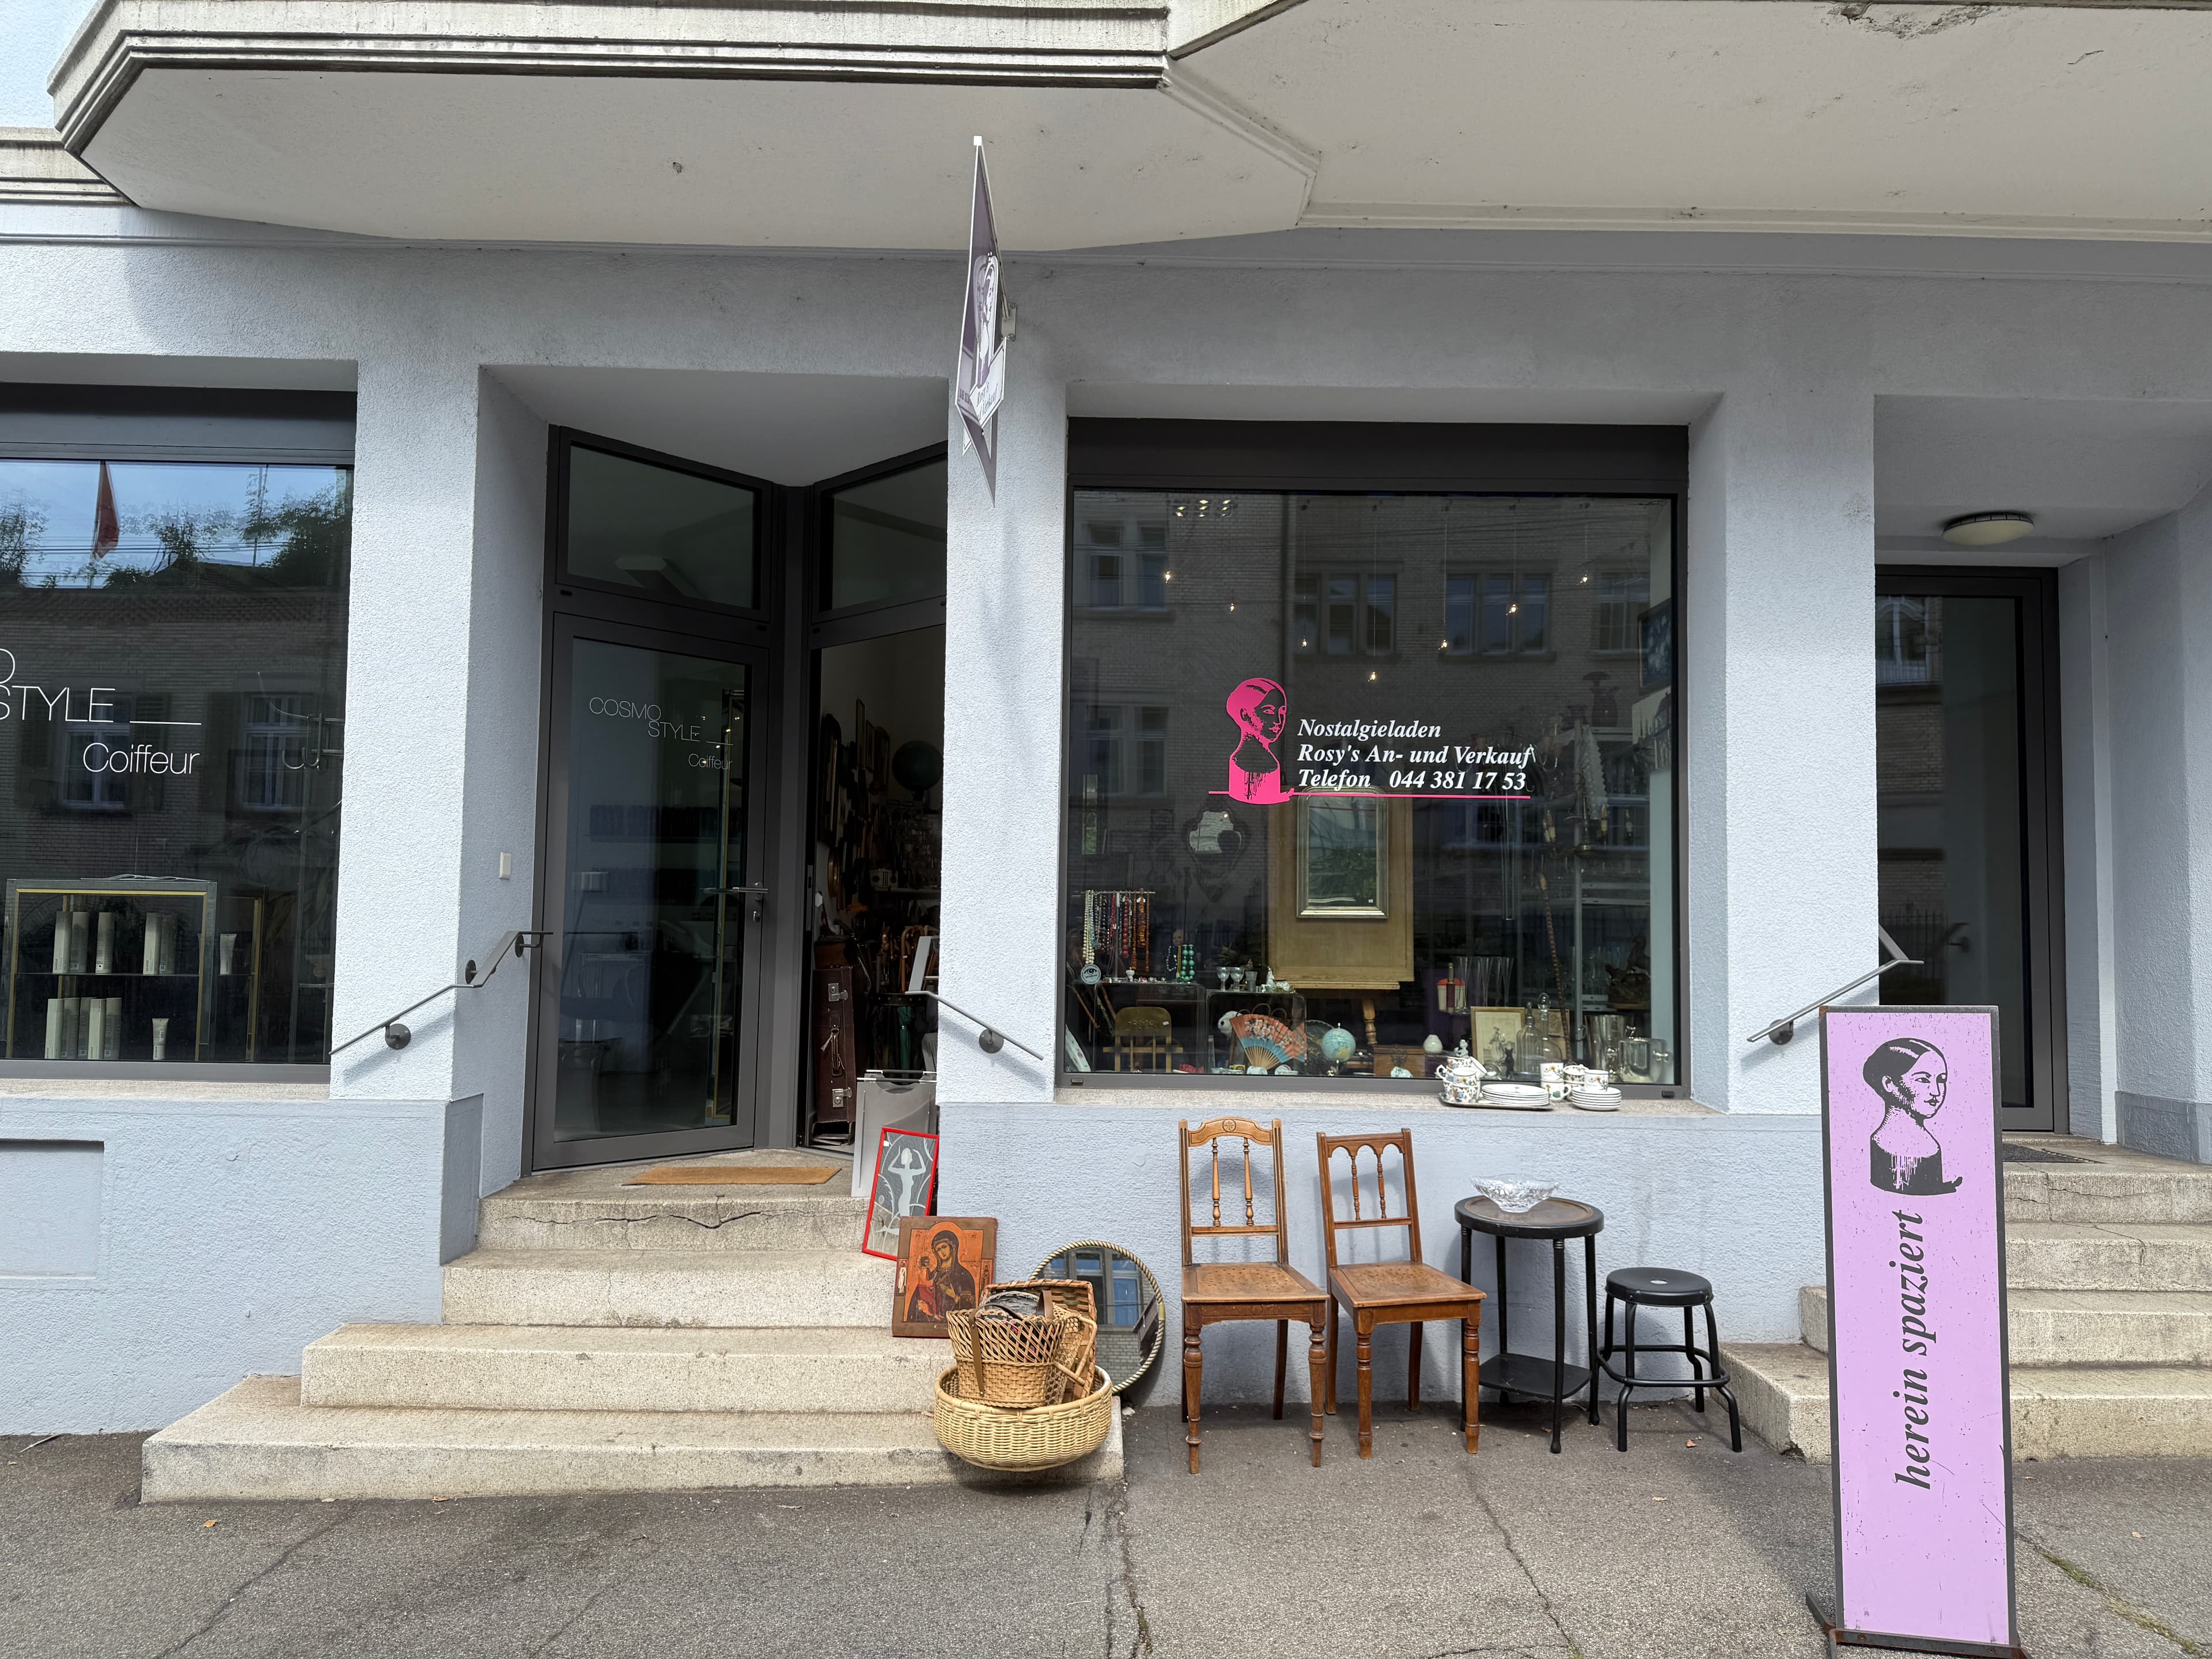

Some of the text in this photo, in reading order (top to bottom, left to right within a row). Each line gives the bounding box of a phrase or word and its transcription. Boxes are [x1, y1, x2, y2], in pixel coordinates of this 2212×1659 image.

[589, 697, 662, 722] COSMO
[647, 721, 701, 742] STYLE
[1297, 719, 1441, 741] Nostalgieladen
[83, 743, 200, 774] Coiffeur
[688, 753, 733, 770] Coiffeur
[1297, 744, 1532, 769] Rosy's An- und Verkauf
[1298, 769, 1526, 791] Telefon 044 381 17 53
[1889, 1210, 1937, 1490] herein spaziert
